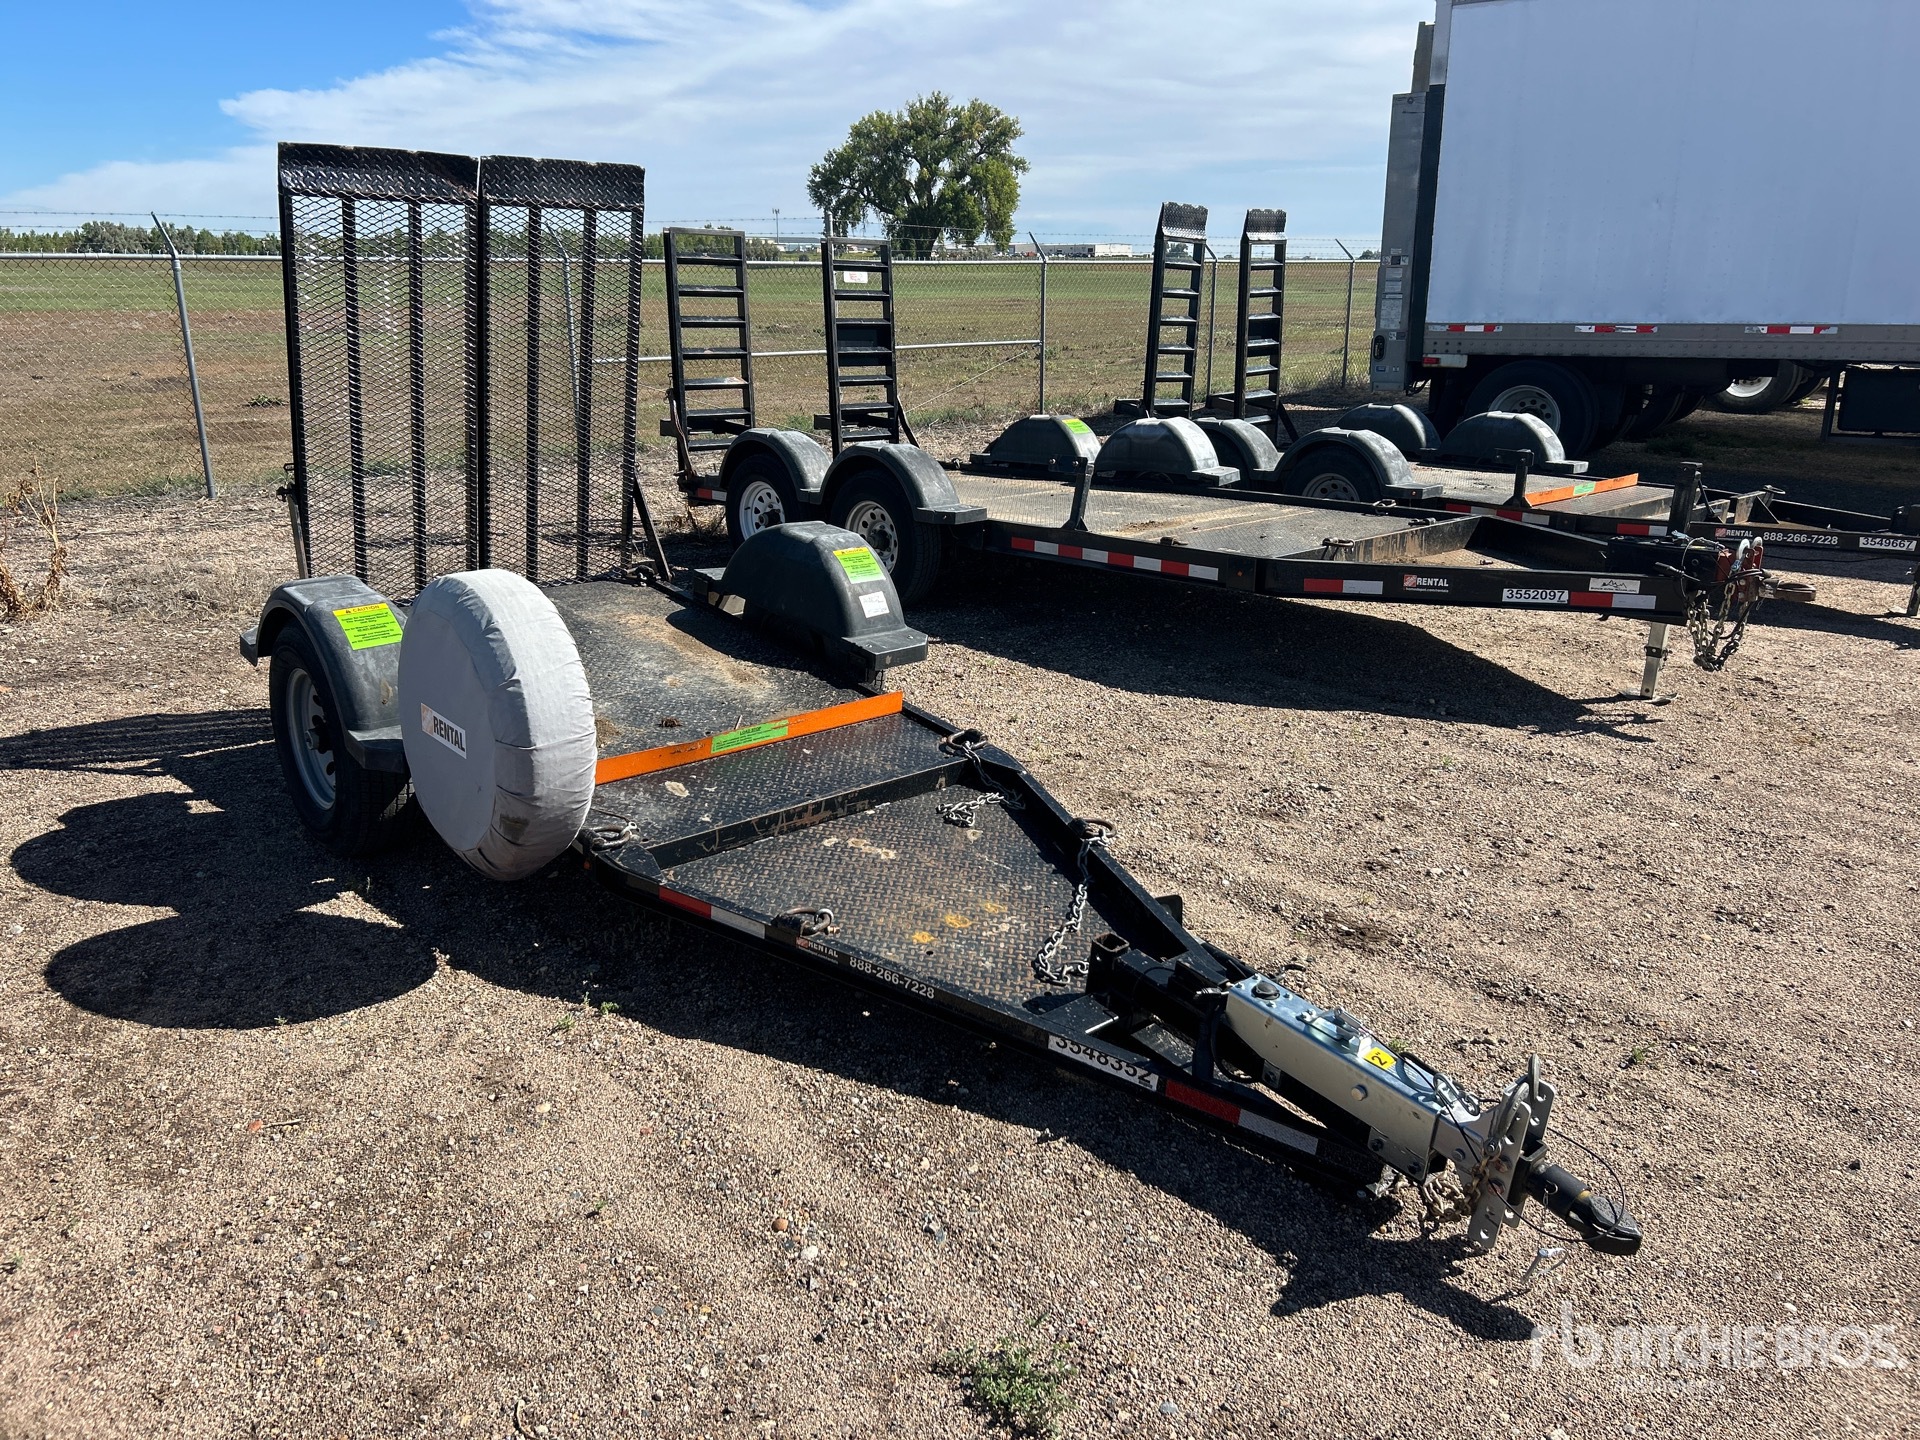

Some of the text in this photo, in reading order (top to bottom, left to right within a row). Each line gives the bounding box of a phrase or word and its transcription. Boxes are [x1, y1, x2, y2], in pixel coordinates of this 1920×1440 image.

[1726, 529, 1753, 537] RENTAL
[1763, 531, 1839, 545] 888-266-7228
[1862, 537, 1914, 549] 3549667
[1416, 577, 1449, 587] RENTAL
[1506, 590, 1566, 602] 3552097
[433, 715, 466, 752] RENTAL
[849, 956, 935, 999] 888-266-7228
[1055, 1038, 1152, 1084] 3548352
